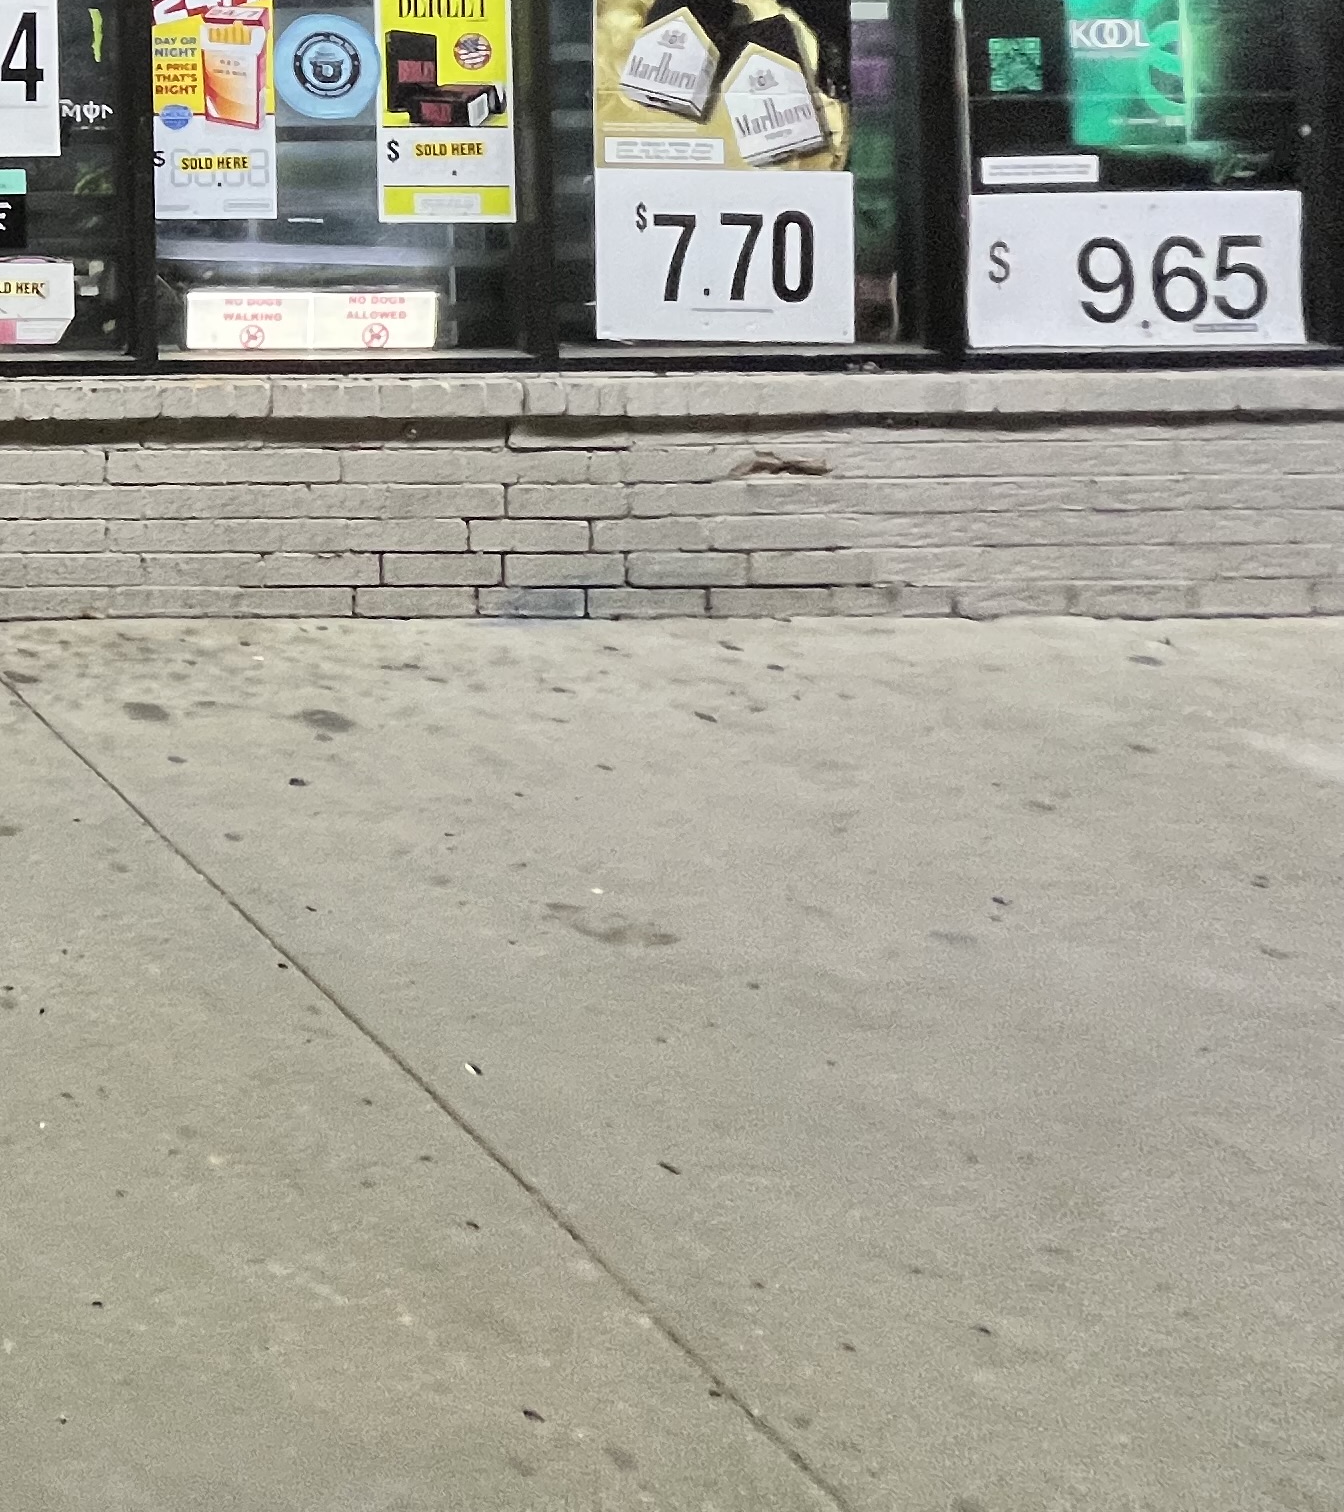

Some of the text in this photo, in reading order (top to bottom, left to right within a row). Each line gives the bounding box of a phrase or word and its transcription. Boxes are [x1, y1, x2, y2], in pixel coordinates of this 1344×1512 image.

[1069, 18, 1151, 48] KOOL
[154, 36, 197, 45] DAY OR
[154, 47, 197, 58] NIGHT
[155, 63, 198, 71] A PRICE
[630, 52, 698, 90] Marlboro
[155, 73, 198, 83] THAT'S
[155, 84, 198, 95] RIGHT
[734, 98, 812, 138] Marlboro
[386, 138, 484, 163] $ SOLD HERE
[181, 157, 212, 170] SOLD
[217, 156, 249, 169] HERE
[988, 239, 1011, 290] $
[348, 296, 406, 304] NO DOGS
[223, 313, 283, 322] WALKING
[346, 310, 407, 320] ALLOWED
